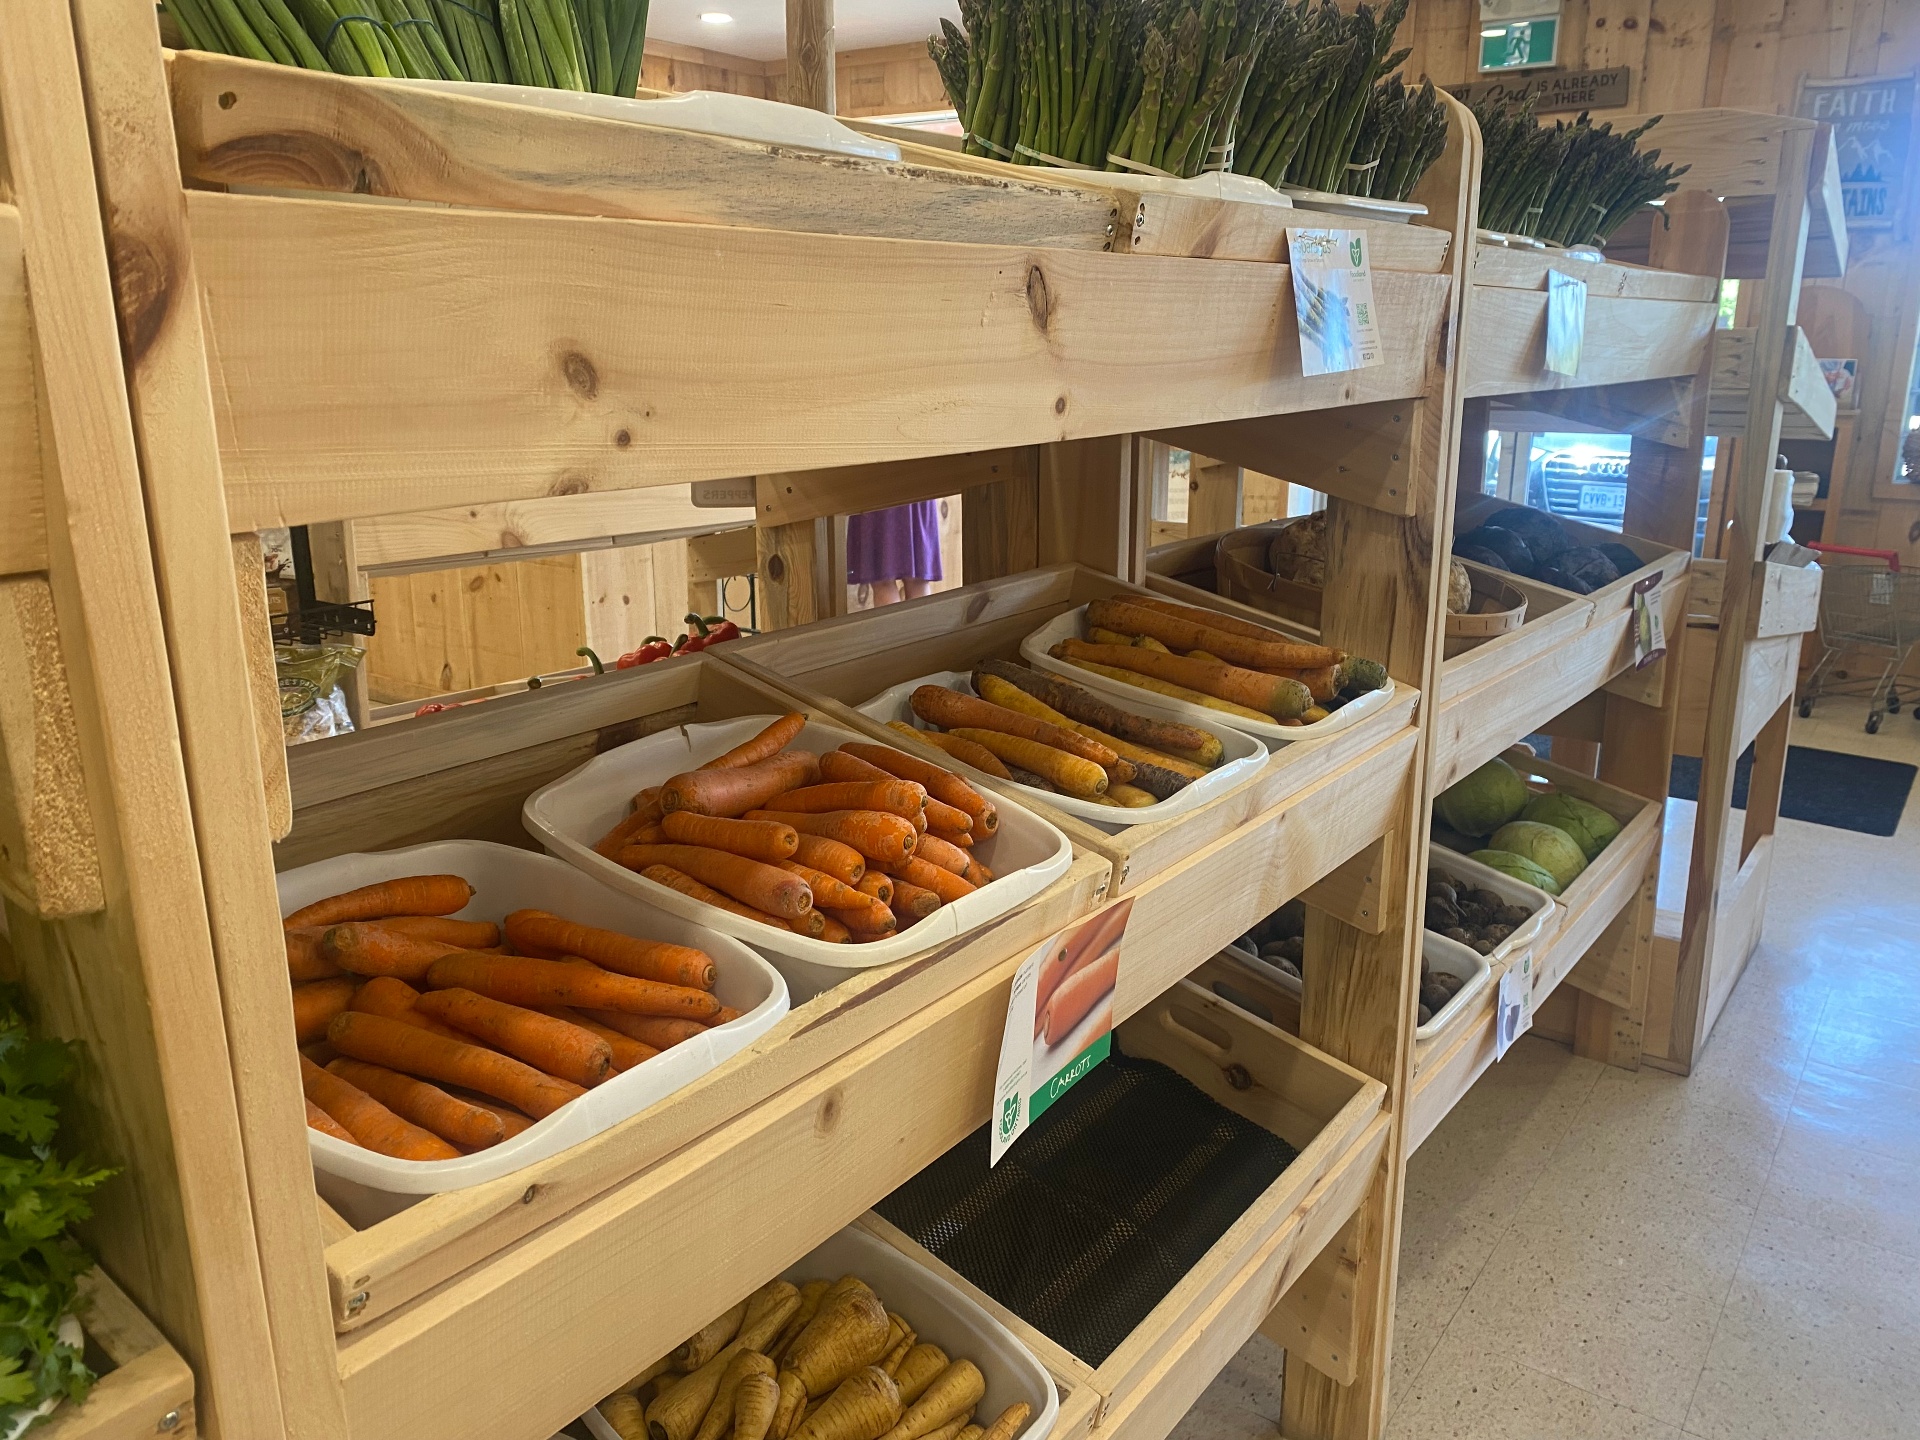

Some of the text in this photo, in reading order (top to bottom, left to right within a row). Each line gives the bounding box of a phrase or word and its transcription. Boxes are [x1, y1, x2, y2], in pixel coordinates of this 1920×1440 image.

[1451, 88, 1471, 101] OT
[1553, 88, 1596, 106] THERE
[1536, 73, 1618, 93] IS ALREADY
[1813, 88, 1897, 118] FAITH
[1841, 187, 1887, 217] TAINS
[1049, 1054, 1092, 1099] CARROTS
